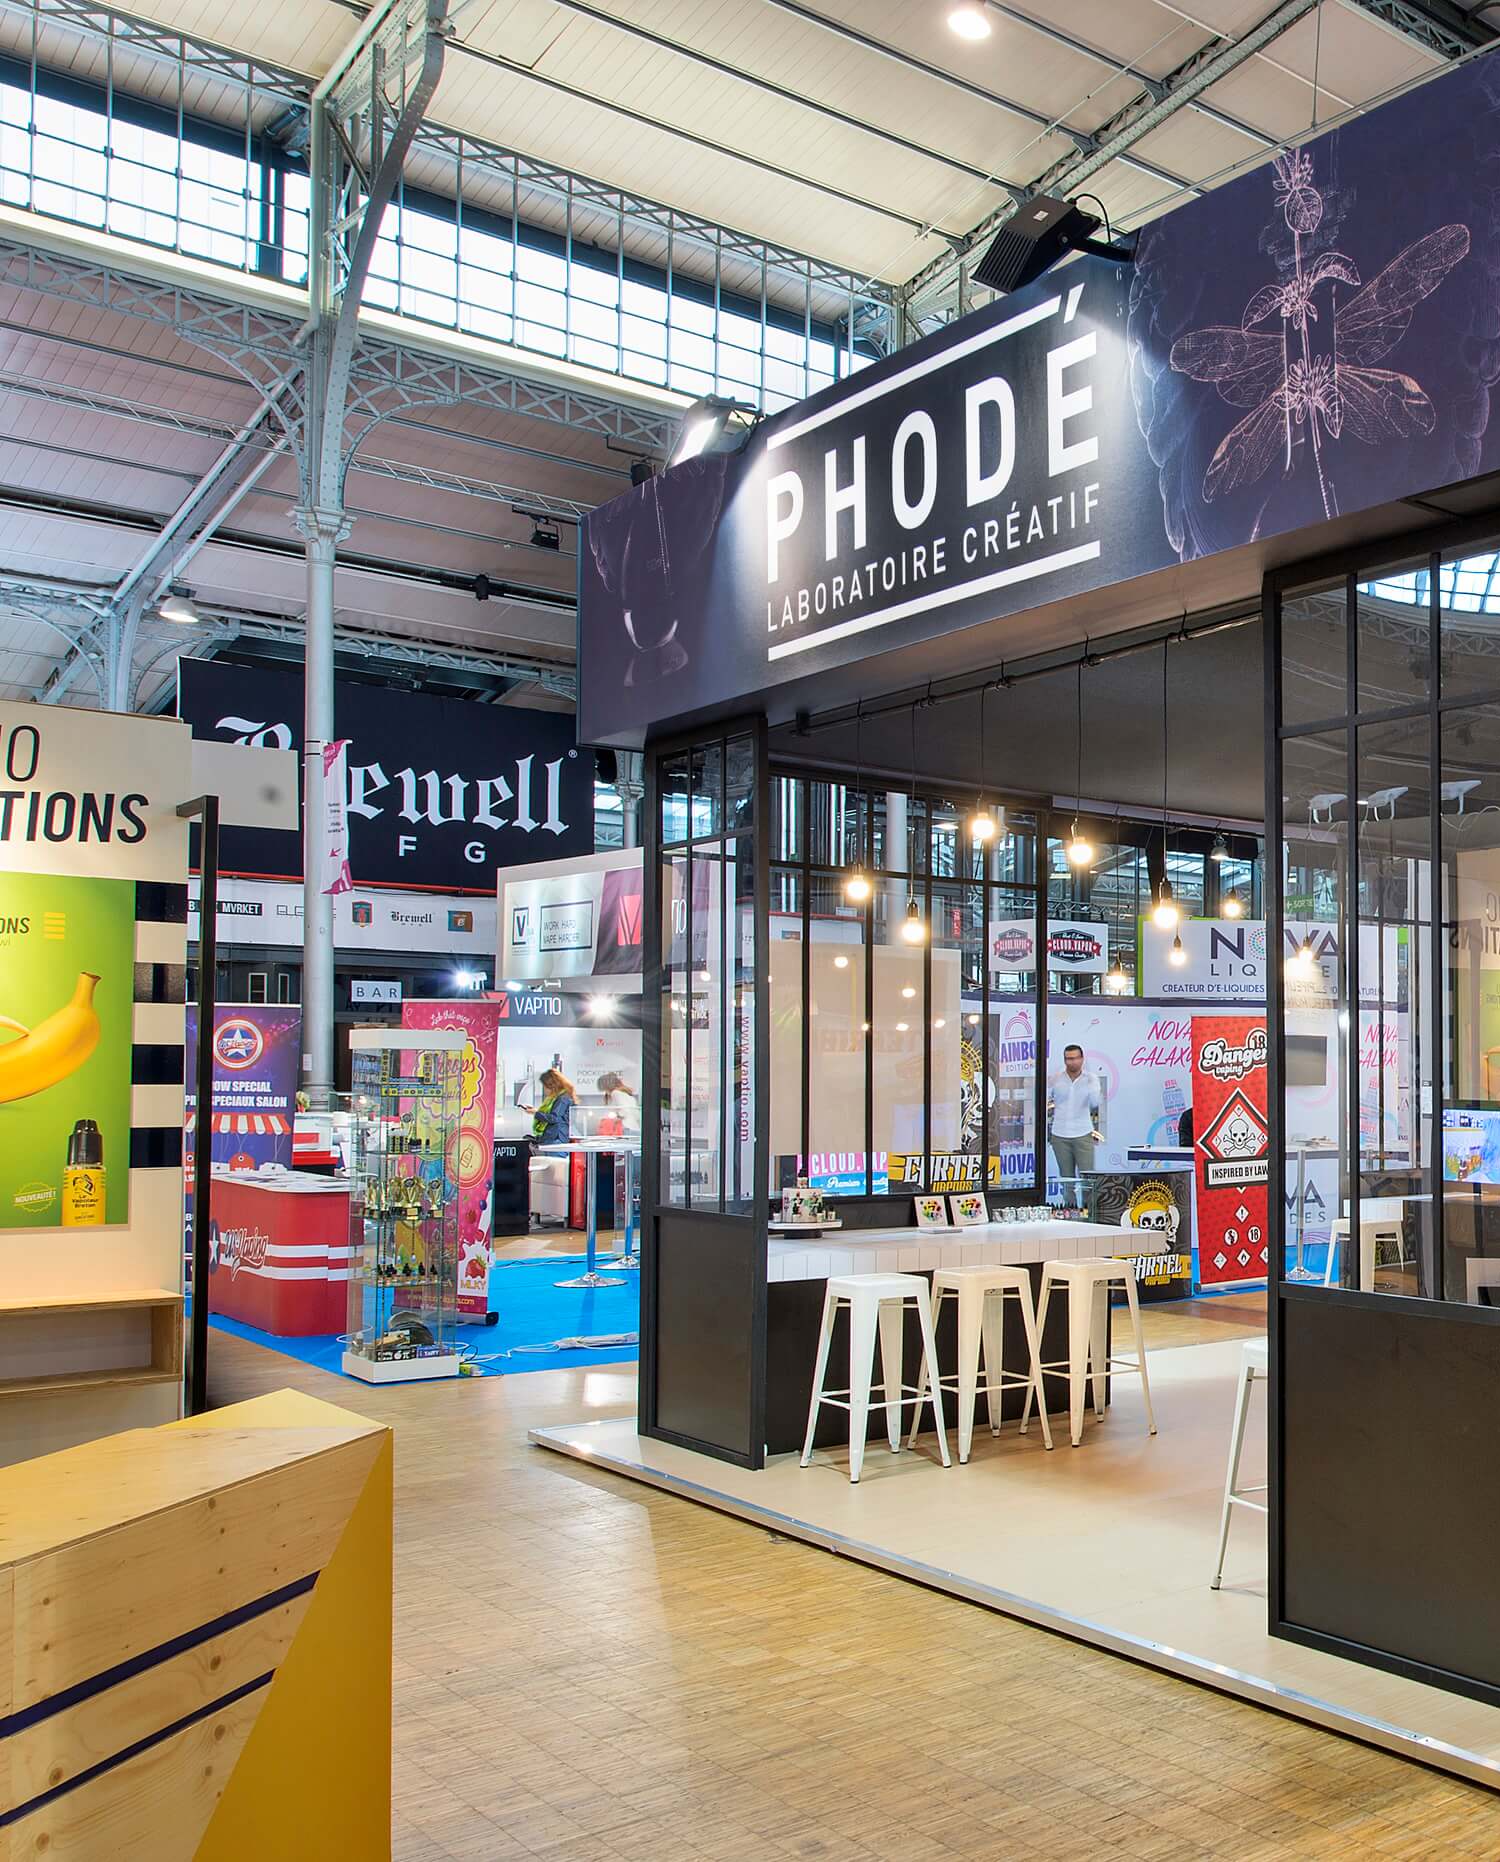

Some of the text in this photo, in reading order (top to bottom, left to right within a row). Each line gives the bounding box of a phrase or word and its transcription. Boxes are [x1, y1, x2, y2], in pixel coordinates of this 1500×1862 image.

[767, 283, 1099, 583] PHODÉ
[766, 482, 1101, 632] LABORATOIRE CRÉATIF
[0, 725, 41, 783] O
[221, 902, 260, 915] MVRKET
[391, 911, 432, 924] Brewell
[356, 986, 397, 998] BAR
[1162, 983, 1205, 993] CREATEUR
[514, 996, 562, 1016] VAPTIO
[1000, 1038, 1050, 1063] AINBO
[1005, 1063, 1034, 1073] EDITION
[212, 1081, 272, 1093] OW SPECIAL
[255, 1096, 288, 1108] SALON
[1000, 1153, 1035, 1176] NOVA
[1212, 1167, 1243, 1180] INSPIRED
[1244, 1166, 1254, 1177] BY
[1127, 1253, 1182, 1283] ARTEL
